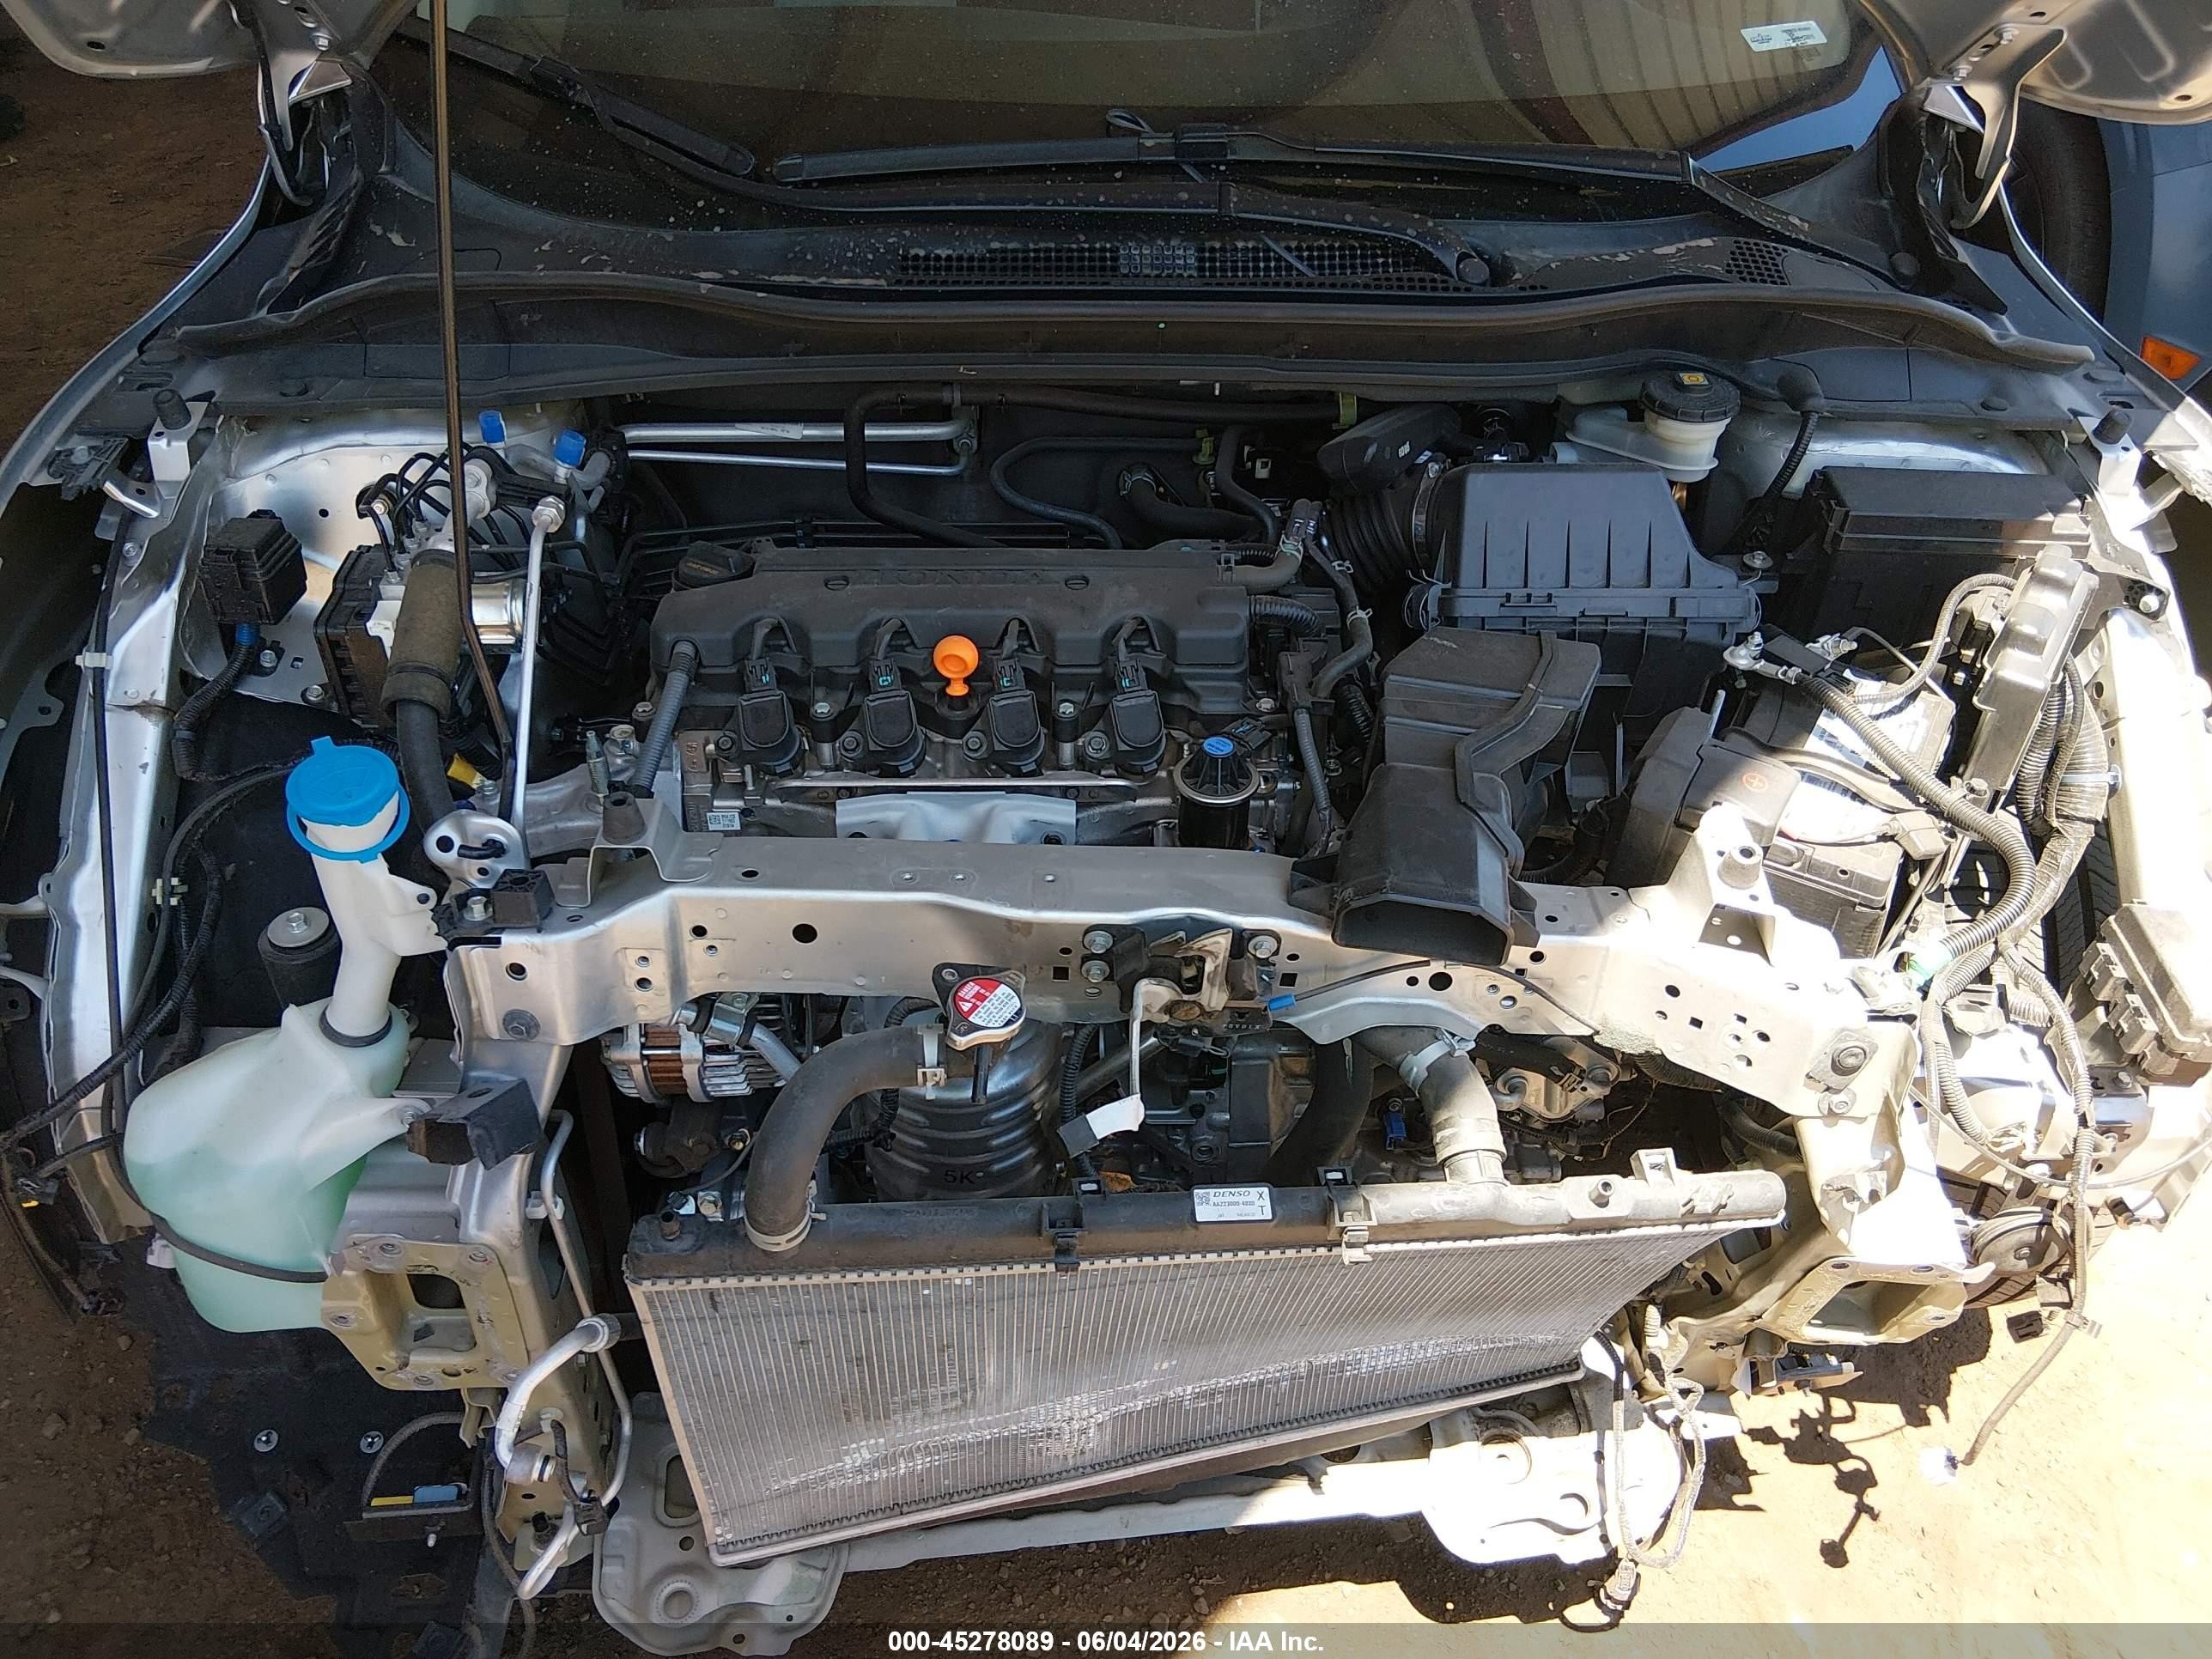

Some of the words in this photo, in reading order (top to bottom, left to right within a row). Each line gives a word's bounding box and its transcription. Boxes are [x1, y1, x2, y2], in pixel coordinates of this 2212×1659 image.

[1213, 1189, 1250, 1198] DENSO
[1256, 1191, 1266, 1200] X
[1258, 1206, 1267, 1216] T
